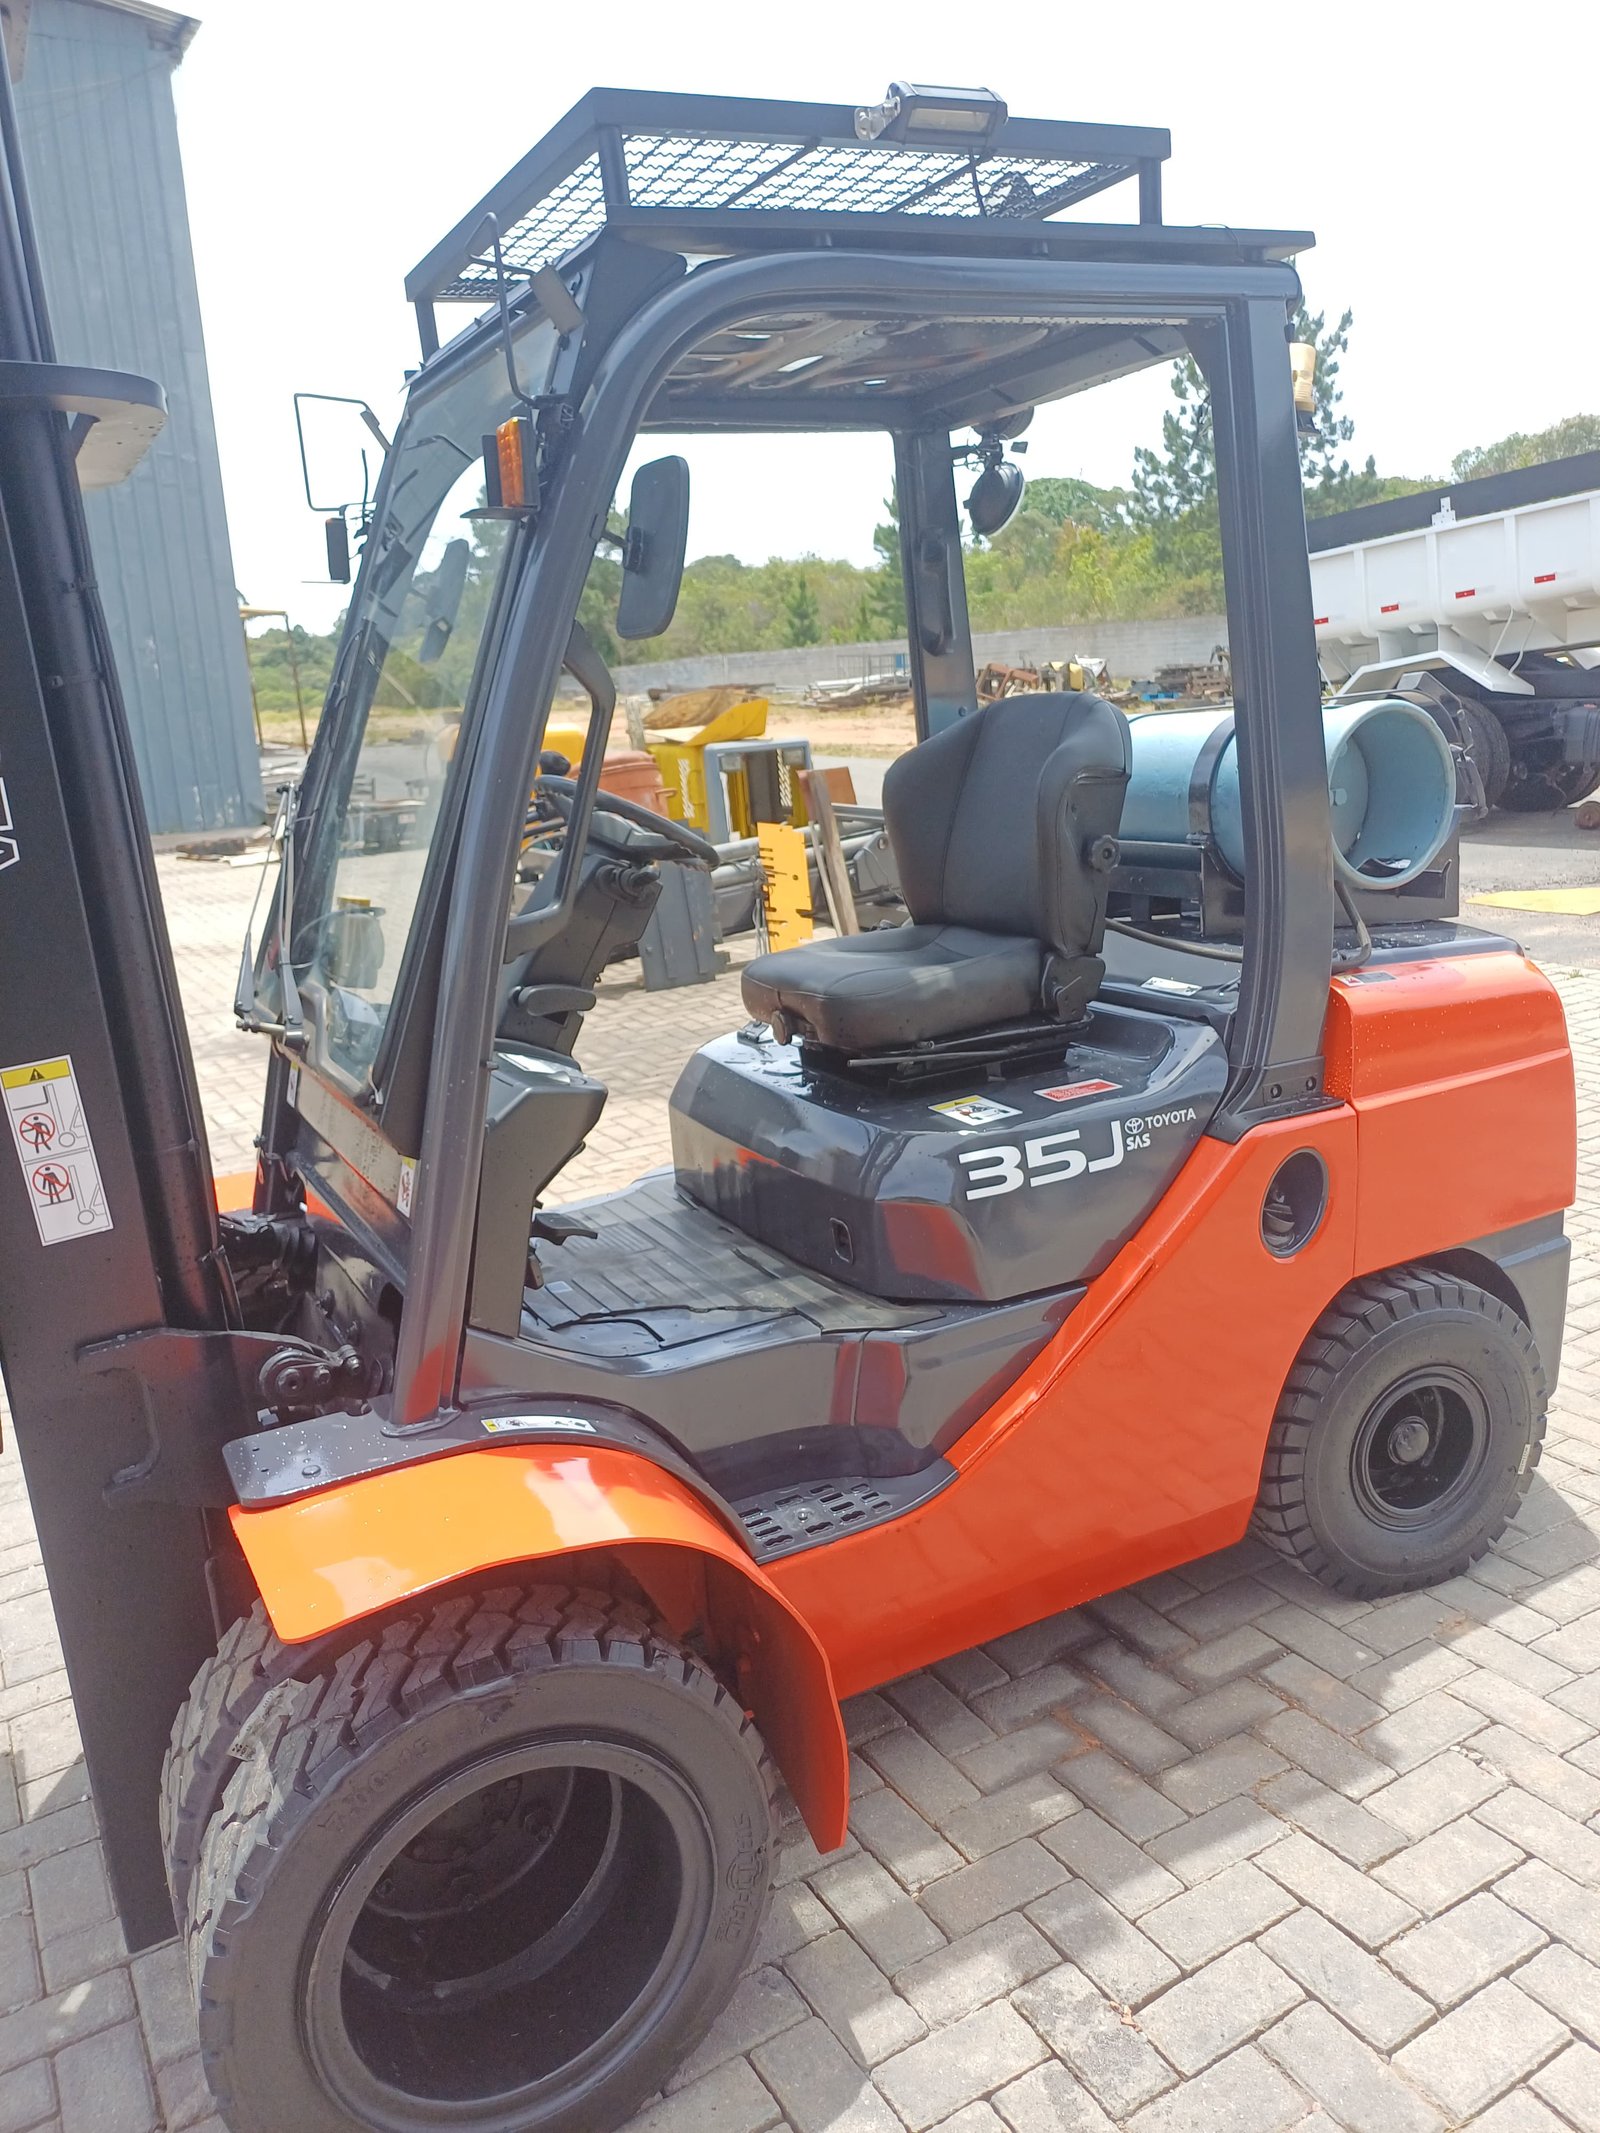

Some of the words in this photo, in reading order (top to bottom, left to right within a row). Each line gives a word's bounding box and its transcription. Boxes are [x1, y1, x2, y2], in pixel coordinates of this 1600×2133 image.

[1145, 1107, 1197, 1129] TOYOTA
[1126, 1132, 1151, 1151] SAS
[958, 1120, 1125, 1200] 35J
